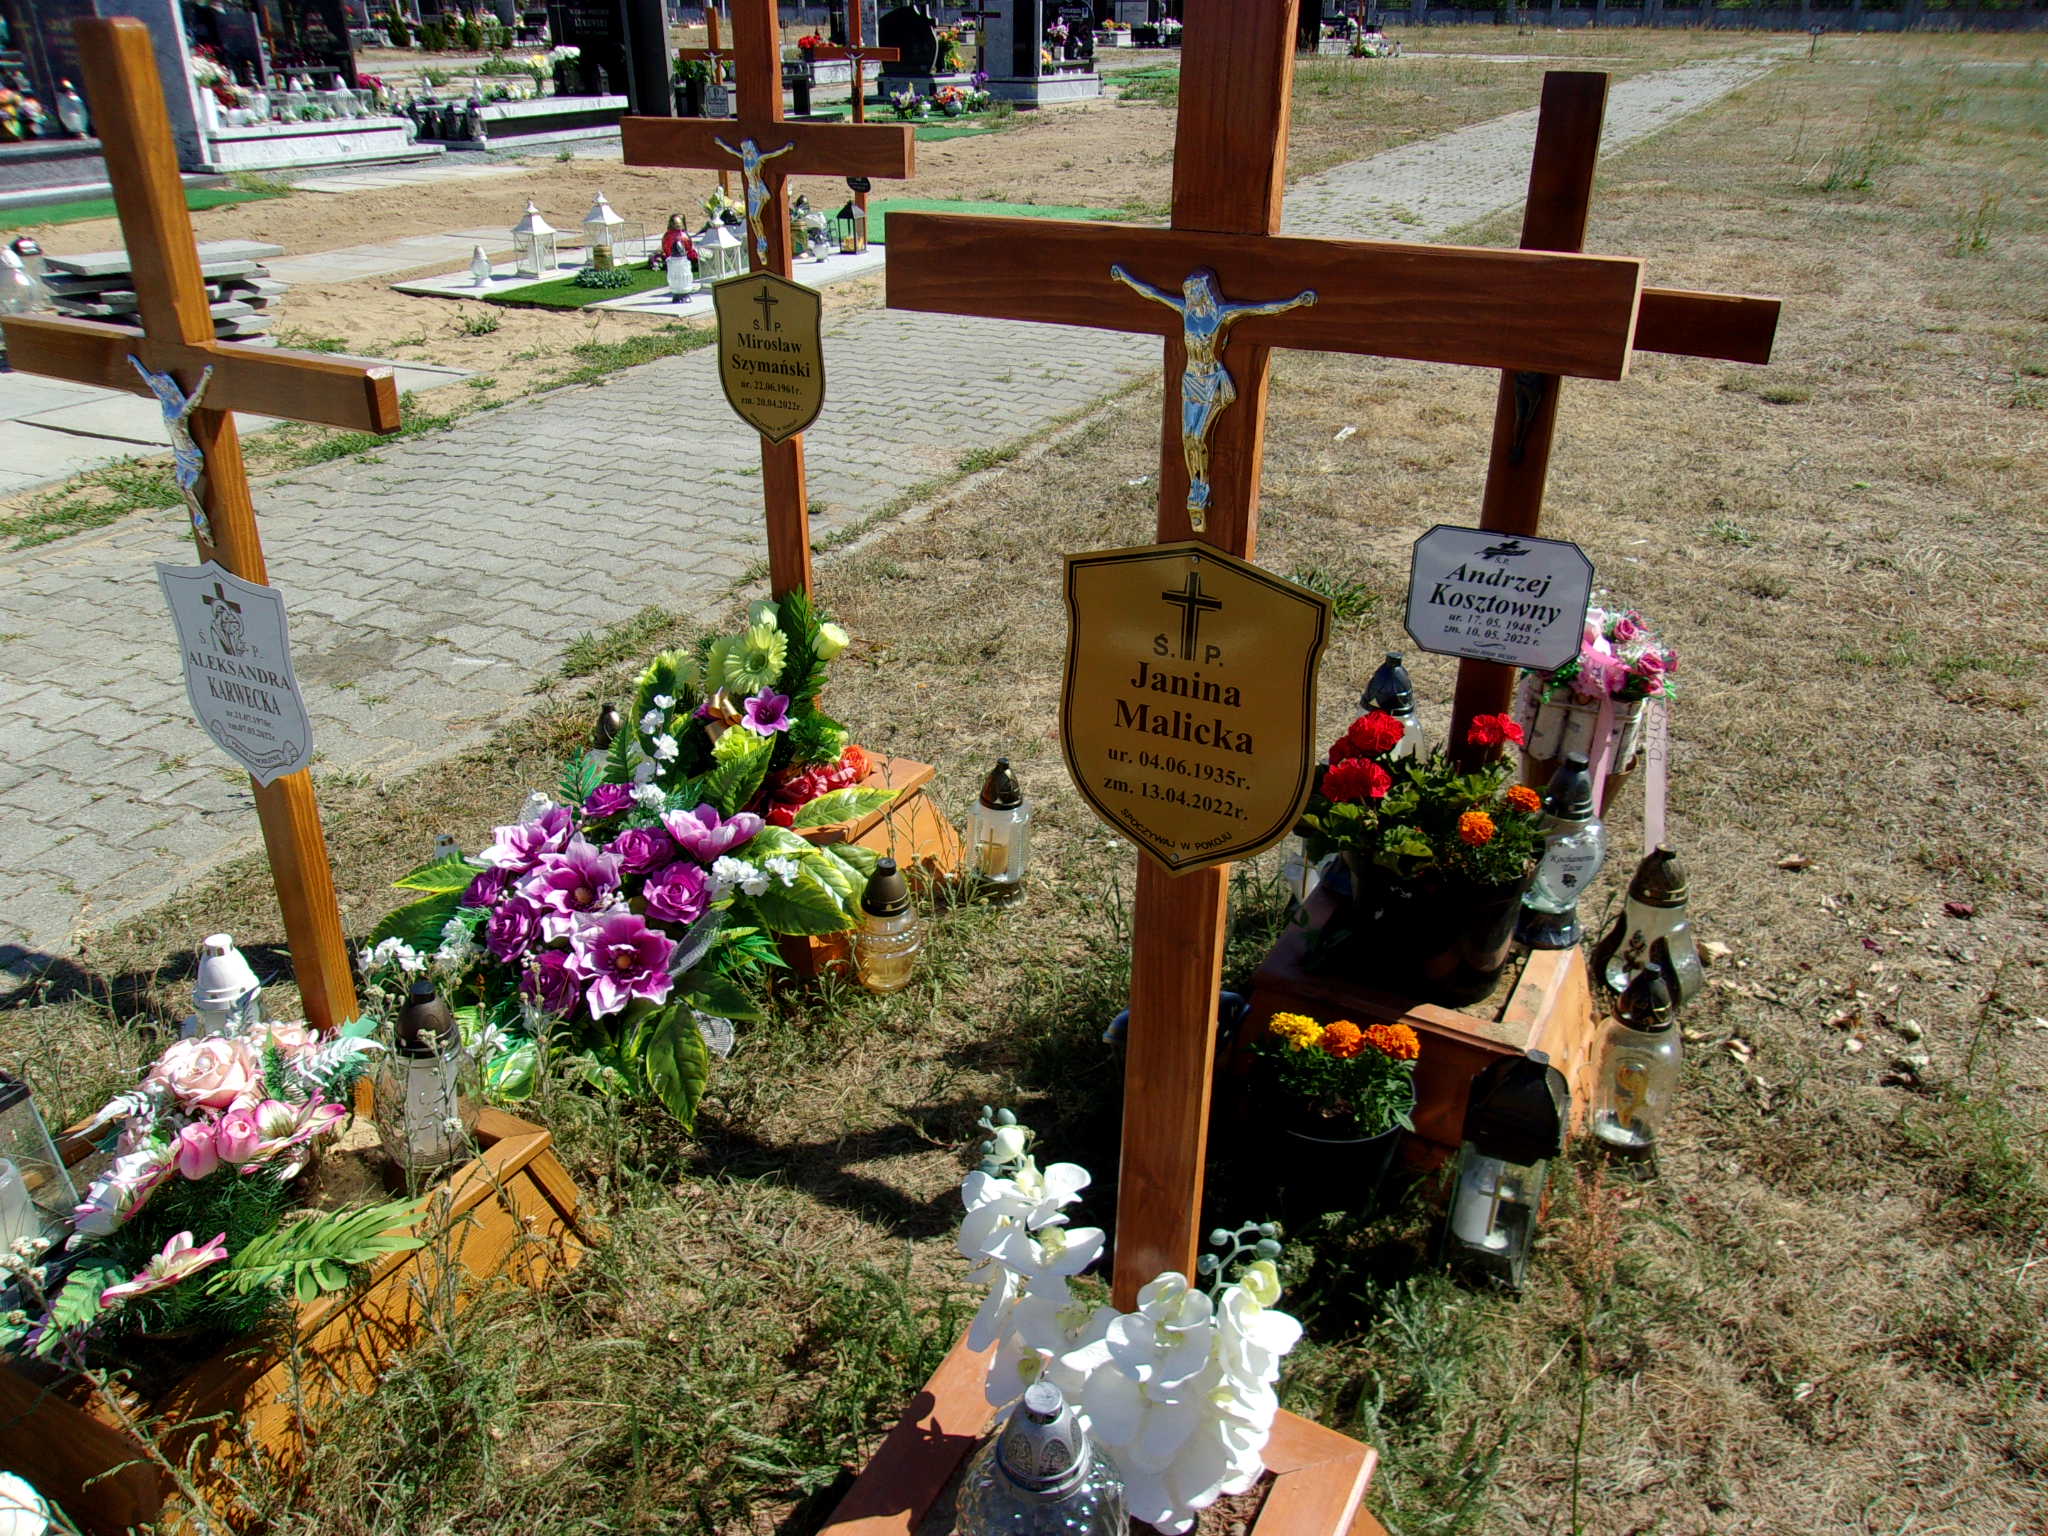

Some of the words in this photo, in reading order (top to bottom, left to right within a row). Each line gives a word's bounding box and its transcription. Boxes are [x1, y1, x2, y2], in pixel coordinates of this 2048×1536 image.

[732, 353, 811, 378] Szymański
[1444, 562, 1553, 599] Andrzej
[1428, 583, 1562, 628] Kosztowny
[1448, 614, 1463, 622] ur.
[1467, 614, 1482, 625] 17.
[1506, 621, 1533, 633] 1948
[1204, 644, 1224, 668] P.
[1504, 632, 1531, 646] 2022
[189, 651, 292, 690] ALEKSANDRA
[1130, 661, 1242, 708] Janina
[207, 676, 281, 716] KARWECKA
[1113, 698, 1255, 755] Malicka
[1108, 747, 1133, 764] ur.
[1139, 751, 1251, 791] 04.06.1935r.
[1103, 777, 1134, 795] zm.
[1140, 782, 1249, 821] 13.04.2022r.
[1120, 807, 1175, 848] SPOCZYWAJ
[1181, 842, 1190, 850] W
[1195, 832, 1232, 850] POKOJU
